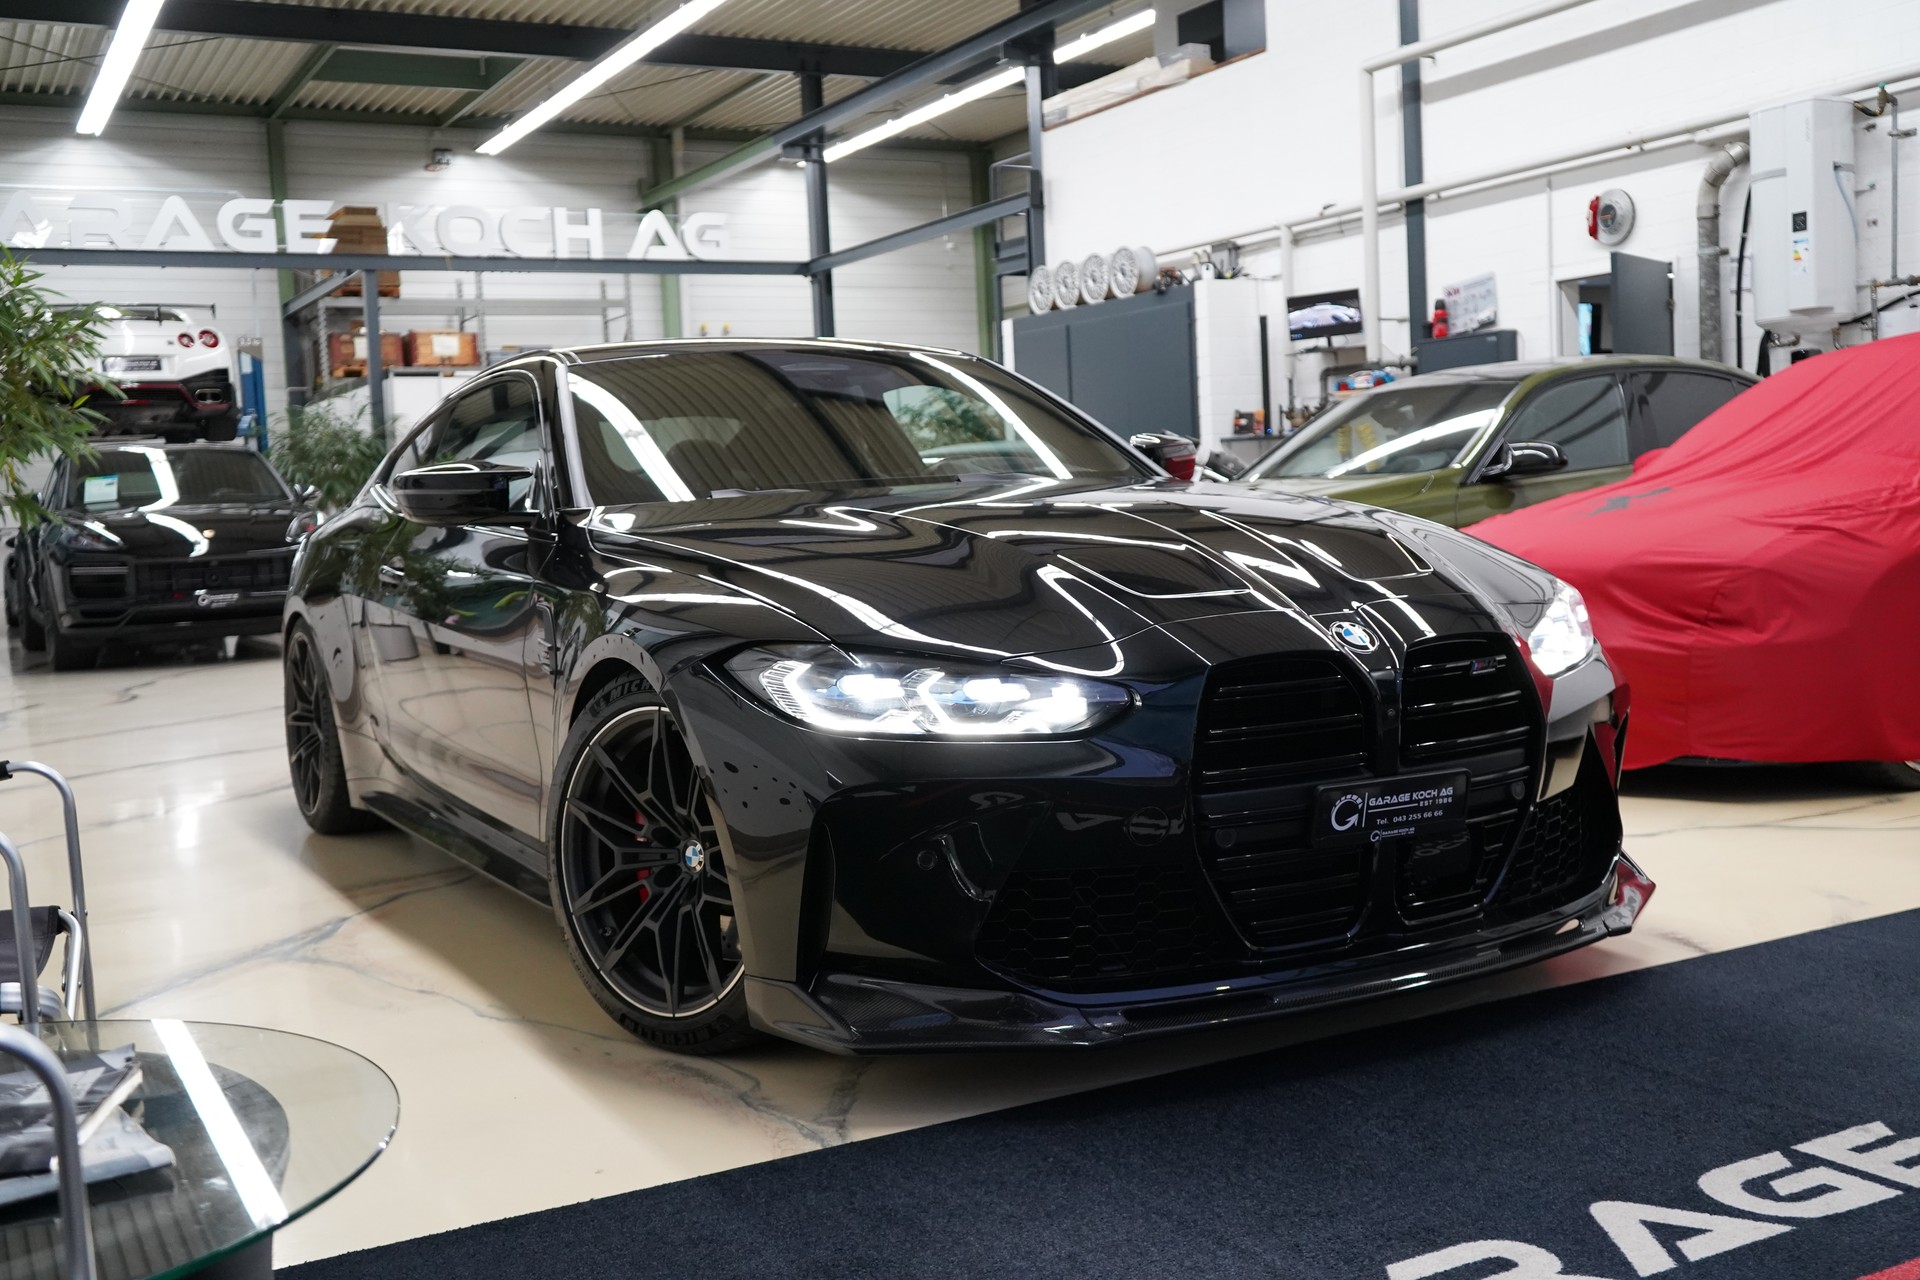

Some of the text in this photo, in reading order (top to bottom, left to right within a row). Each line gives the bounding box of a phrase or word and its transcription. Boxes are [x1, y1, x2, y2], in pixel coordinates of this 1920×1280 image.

[387, 204, 604, 259] KOCH
[627, 208, 732, 262] AG
[1368, 787, 1454, 806] GARAGE KOCH AG
[1393, 815, 1407, 823] 043
[1386, 1121, 1920, 1280] RAGE
